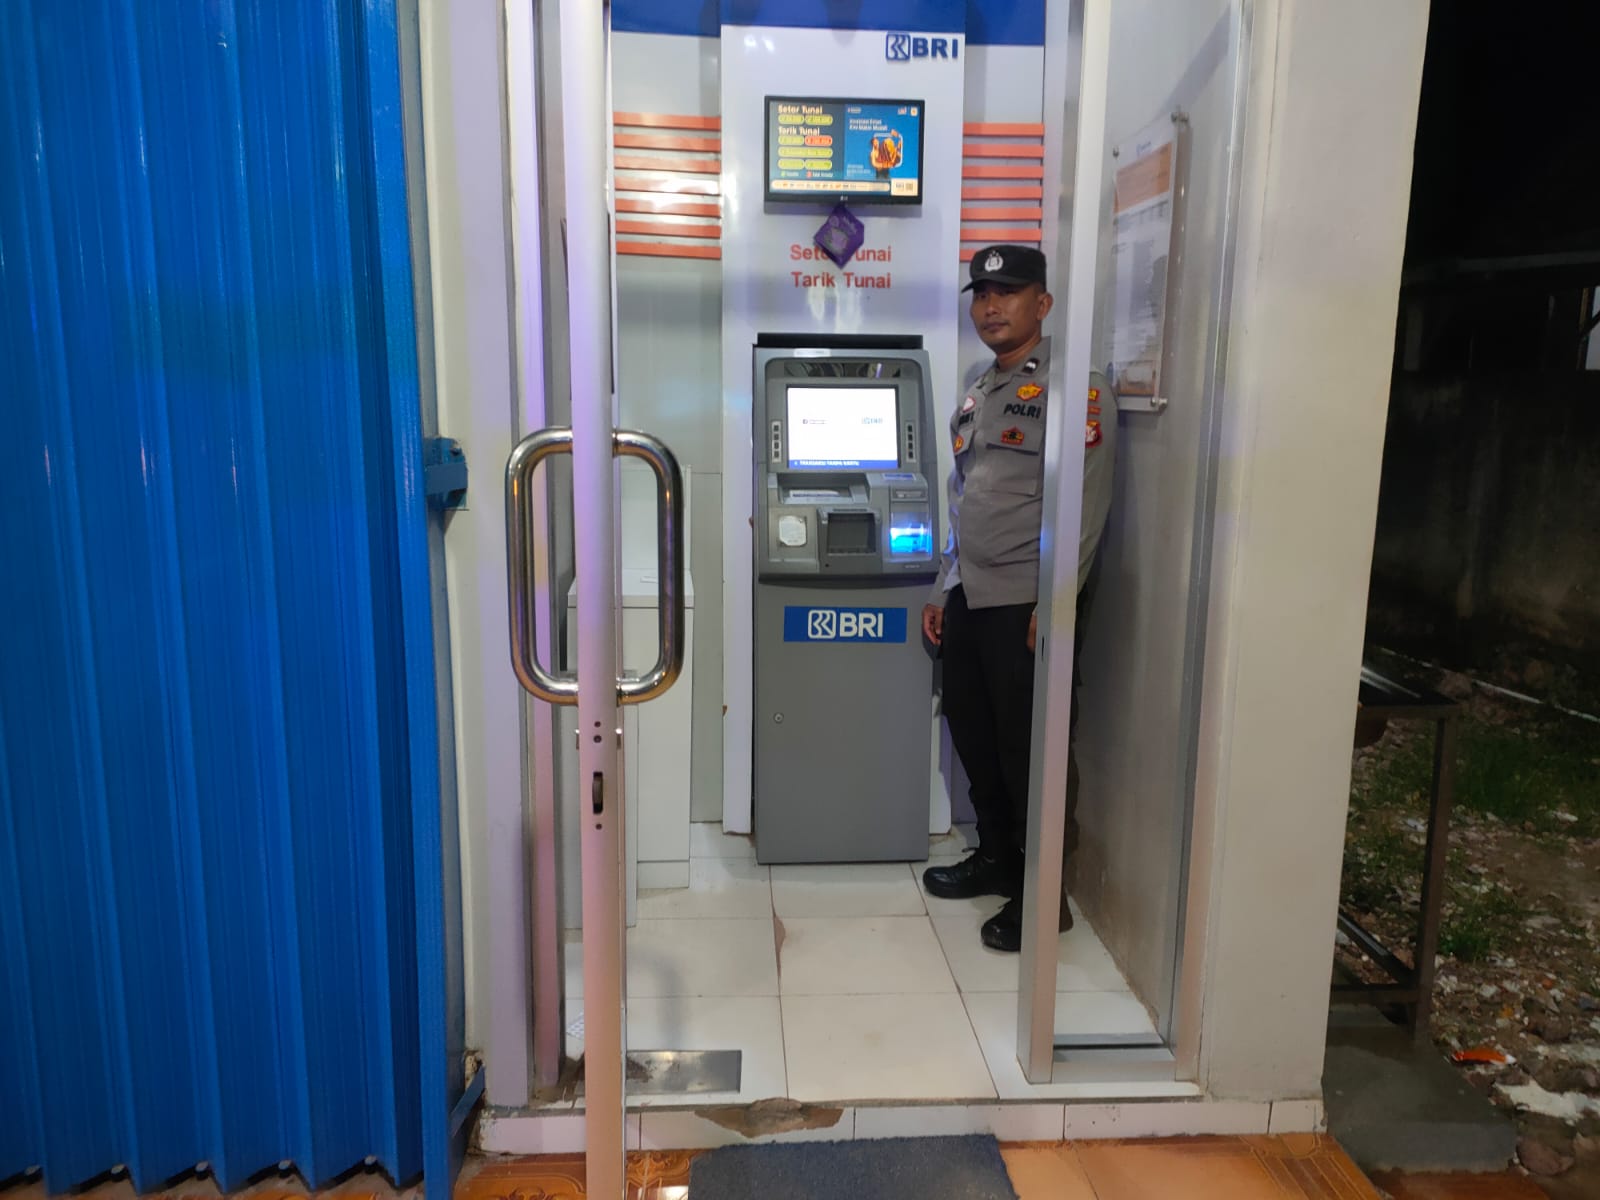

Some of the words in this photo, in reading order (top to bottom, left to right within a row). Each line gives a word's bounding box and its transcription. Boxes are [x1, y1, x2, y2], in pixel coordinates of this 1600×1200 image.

[912, 37, 958, 58] BRI
[855, 245, 891, 262] unai
[791, 271, 835, 288] Tarik
[843, 272, 891, 289] Tunai
[1003, 403, 1042, 419] POLRI
[839, 612, 884, 638] BRI
